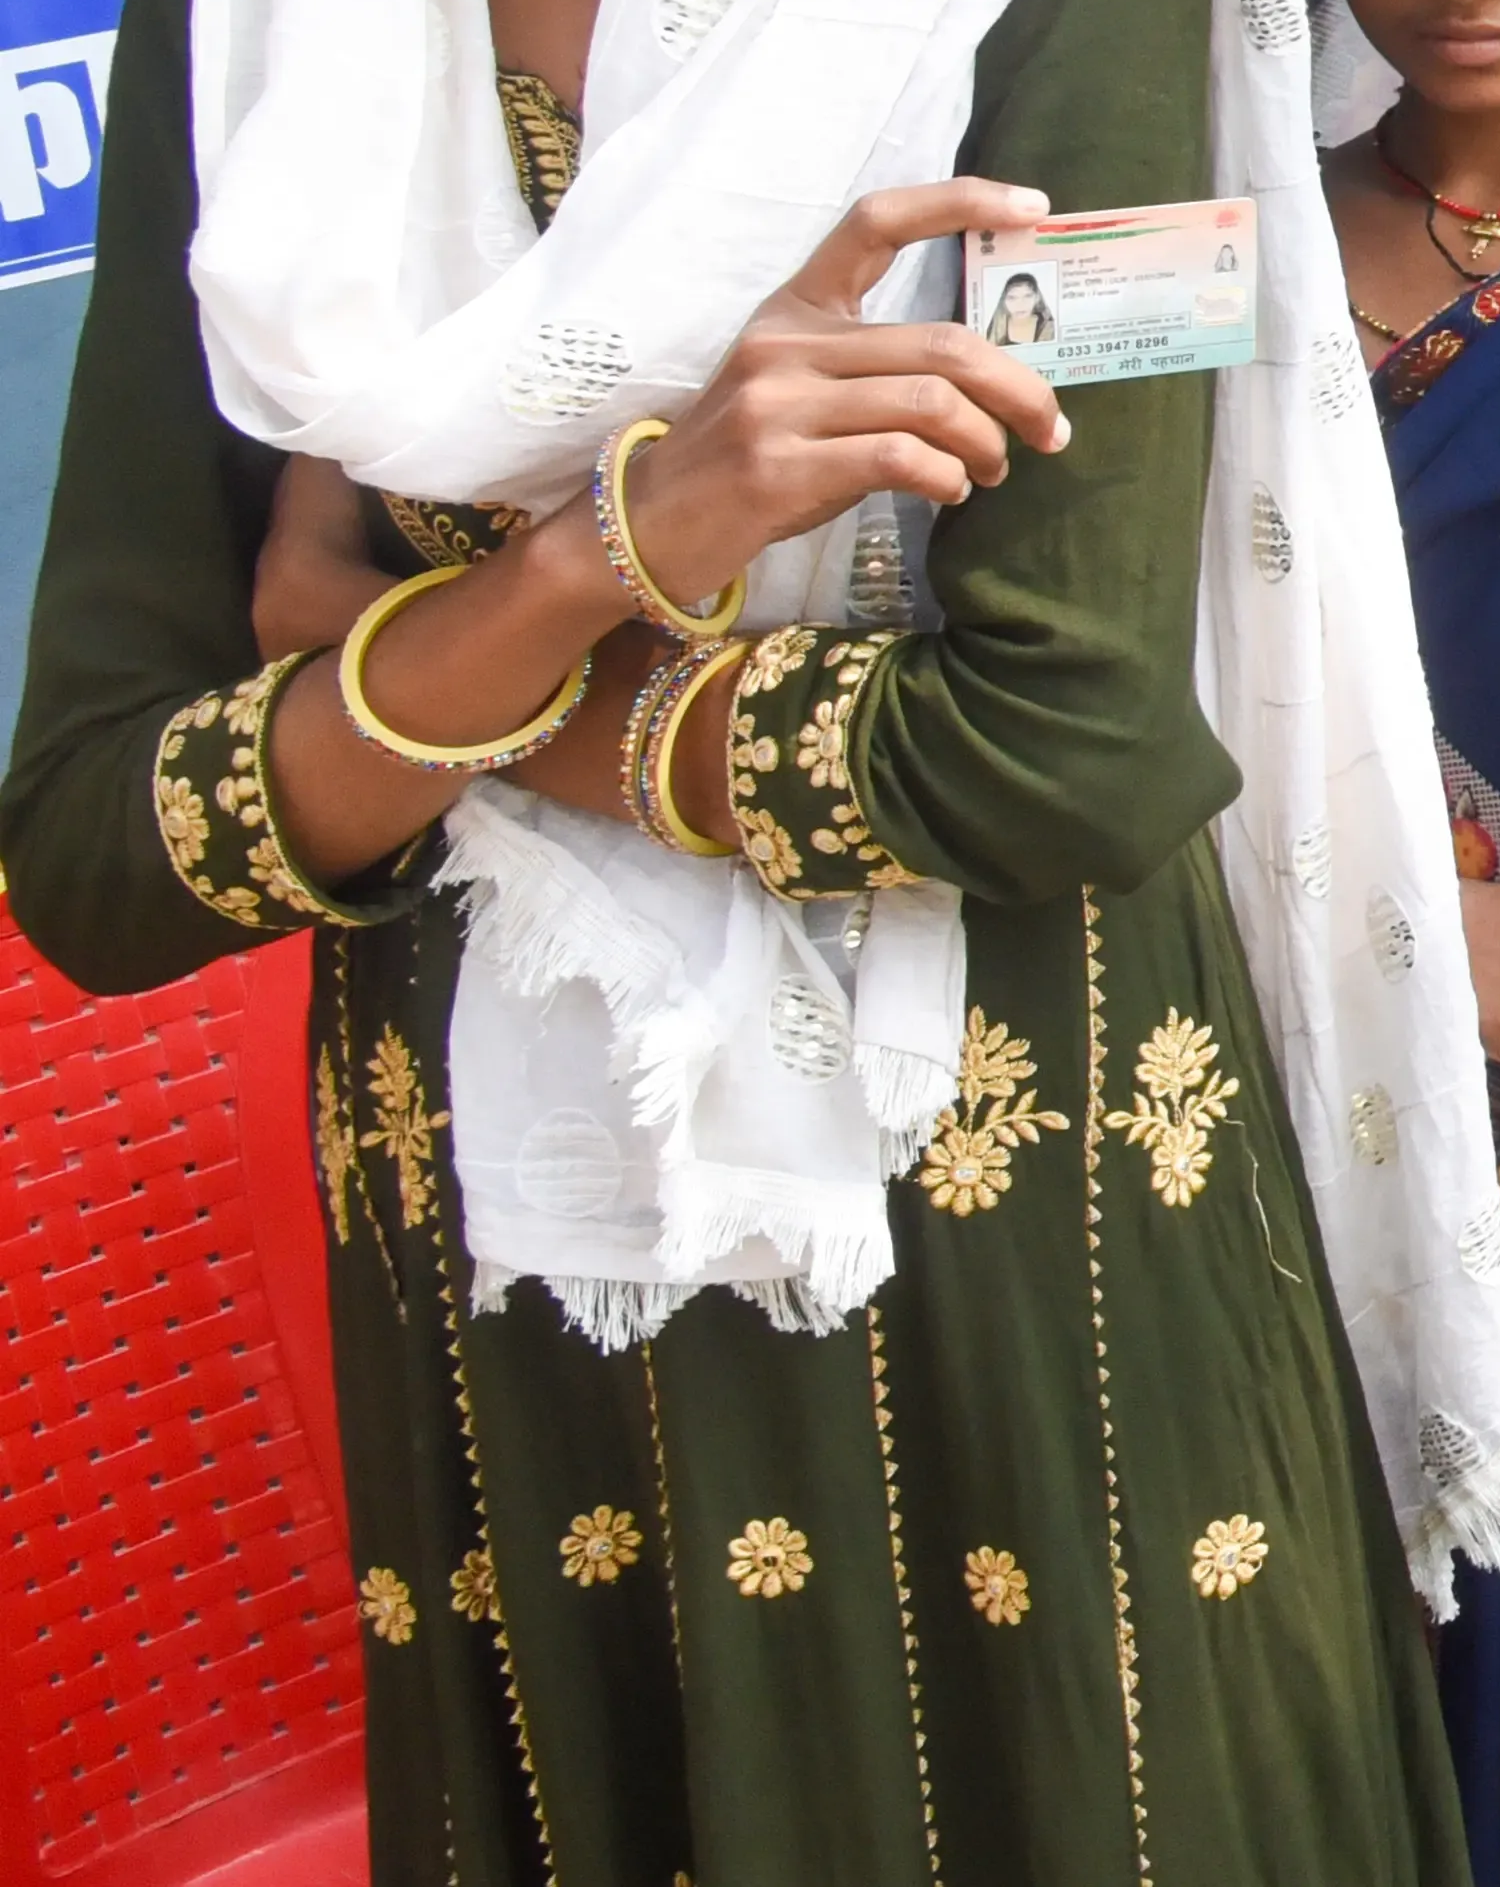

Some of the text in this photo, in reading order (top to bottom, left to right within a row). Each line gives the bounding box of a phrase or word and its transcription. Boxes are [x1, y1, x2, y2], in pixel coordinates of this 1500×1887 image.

[1057, 335, 1169, 358] 6333 3947 8296
[1119, 356, 1142, 372] मेरी
[1150, 352, 1197, 370] पहचान
